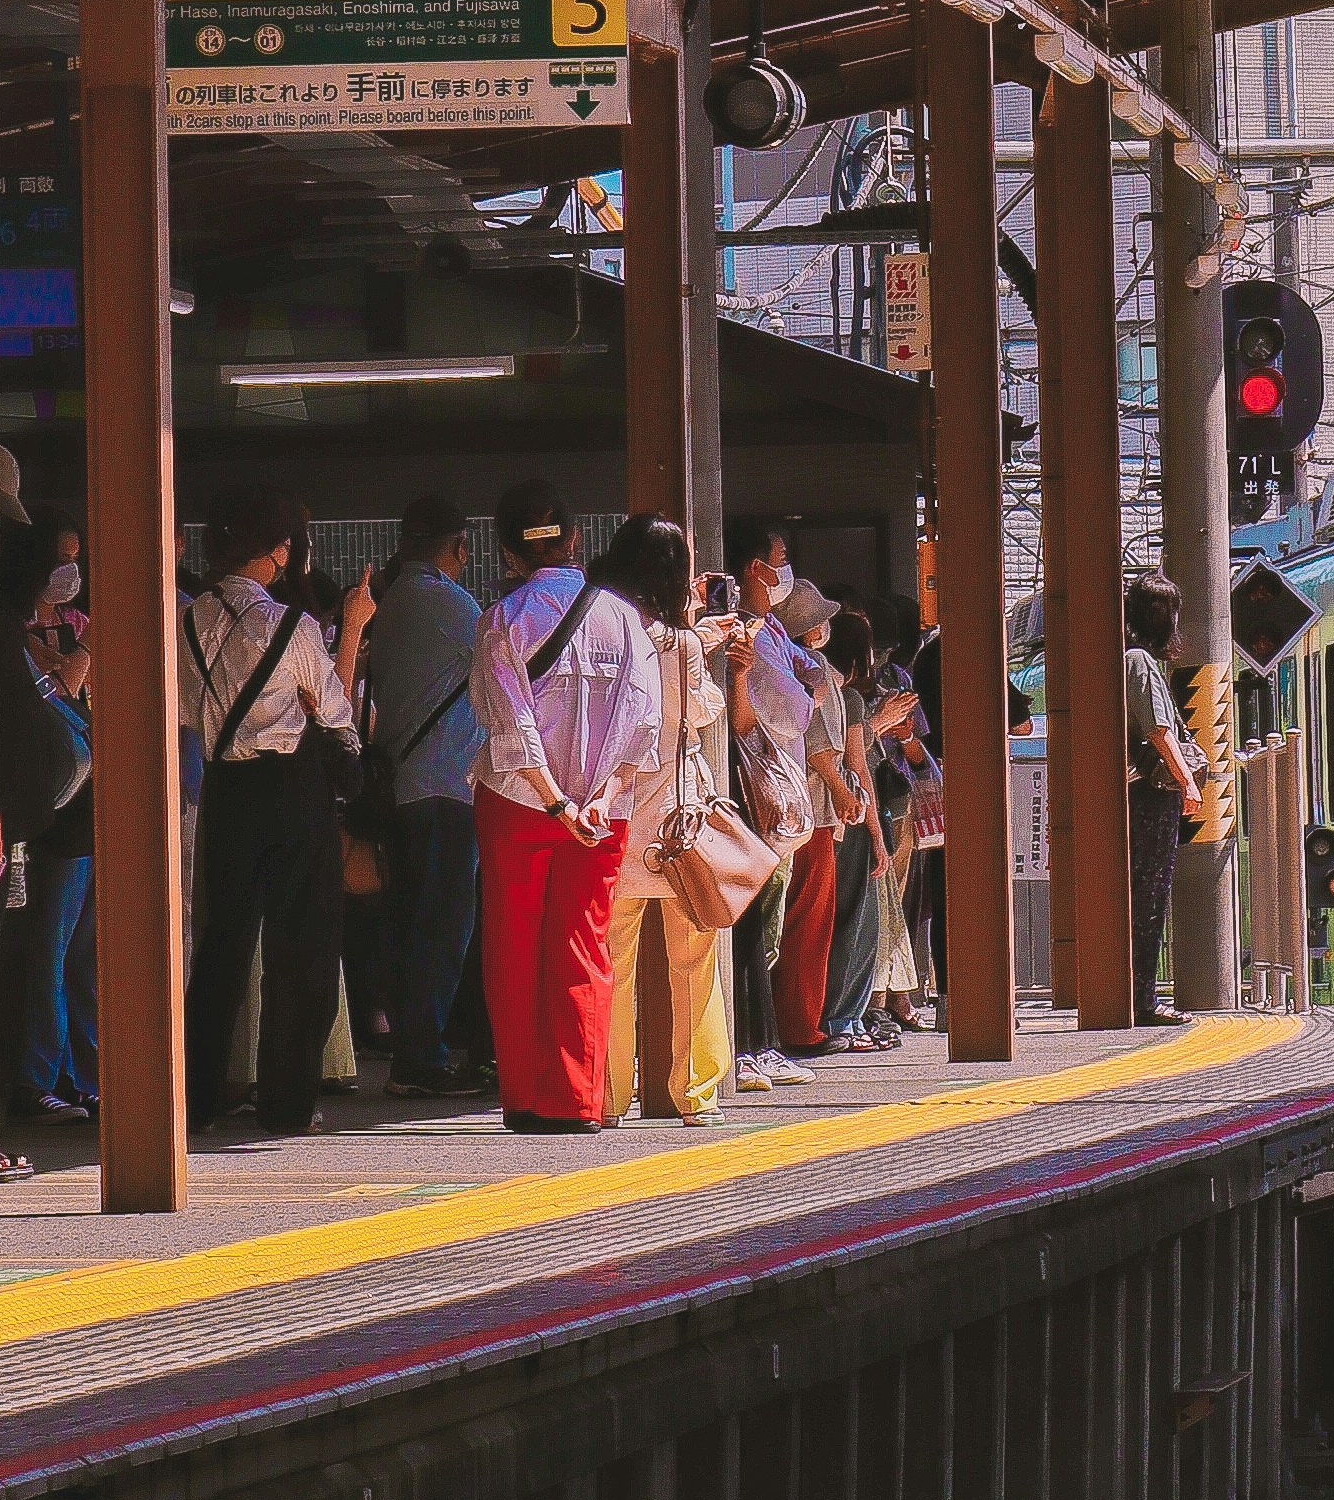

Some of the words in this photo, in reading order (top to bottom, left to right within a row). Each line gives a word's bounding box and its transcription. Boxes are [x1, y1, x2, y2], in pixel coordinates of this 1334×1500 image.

[180, 5, 222, 19] Hase,
[227, 3, 337, 20] Inamuragasaki,
[343, 0, 418, 16] Enoshima,
[424, 0, 450, 12] and
[203, 36, 219, 50] 14
[260, 35, 277, 49] 01
[167, 114, 183, 128] ith
[186, 114, 222, 129] 2cars
[226, 113, 253, 128] stop
[256, 112, 269, 127] at
[272, 111, 297, 126] this
[299, 110, 334, 129] point.
[338, 109, 383, 125] Please
[386, 106, 424, 123] board
[427, 105, 468, 122] before
[472, 105, 496, 121] this
[498, 104, 535, 122] point.
[19, 175, 55, 195] 両数
[1239, 455, 1258, 475] 71
[1271, 455, 1281, 474] L
[1243, 479, 1280, 496] 出発
